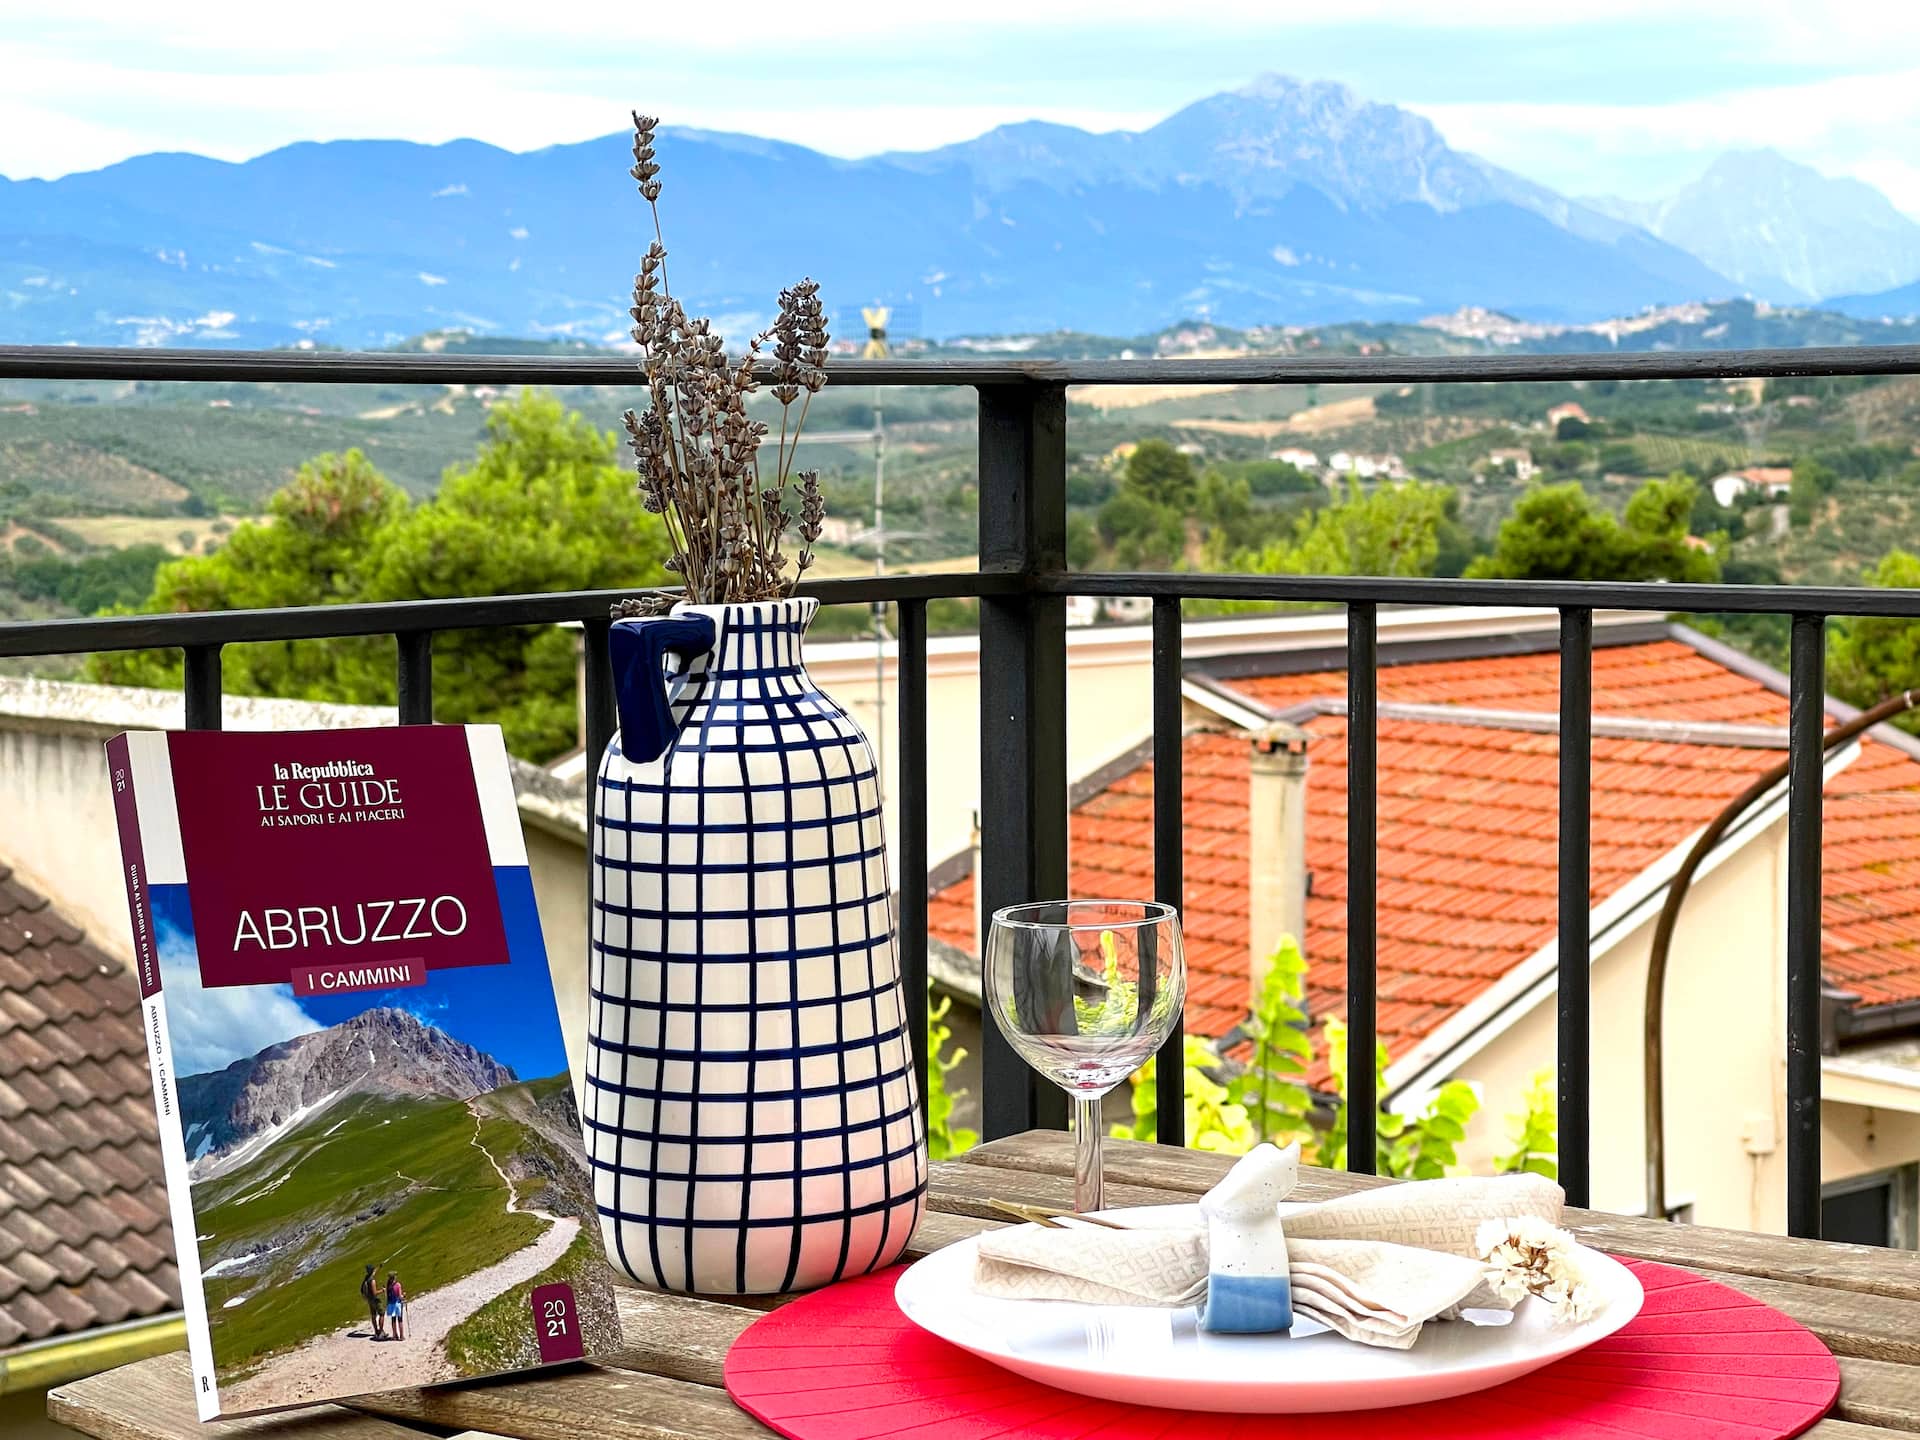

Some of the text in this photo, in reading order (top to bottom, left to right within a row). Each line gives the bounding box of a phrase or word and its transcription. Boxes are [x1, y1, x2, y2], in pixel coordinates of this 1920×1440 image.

[273, 760, 374, 782] la Repubblica
[116, 780, 126, 792] 21
[256, 779, 402, 811] LE GUIDE
[261, 808, 405, 827] AI SAPORI E AI PIACERI
[130, 864, 140, 891] GUIDA
[233, 895, 467, 951] ABRUZZO
[308, 965, 411, 990] I CAMMINI
[150, 1005, 162, 1054] ABRUZZO
[159, 1069, 171, 1116] CAMMINI
[543, 1300, 566, 1318] 20
[546, 1319, 567, 1337] 21
[201, 1375, 210, 1392] R
